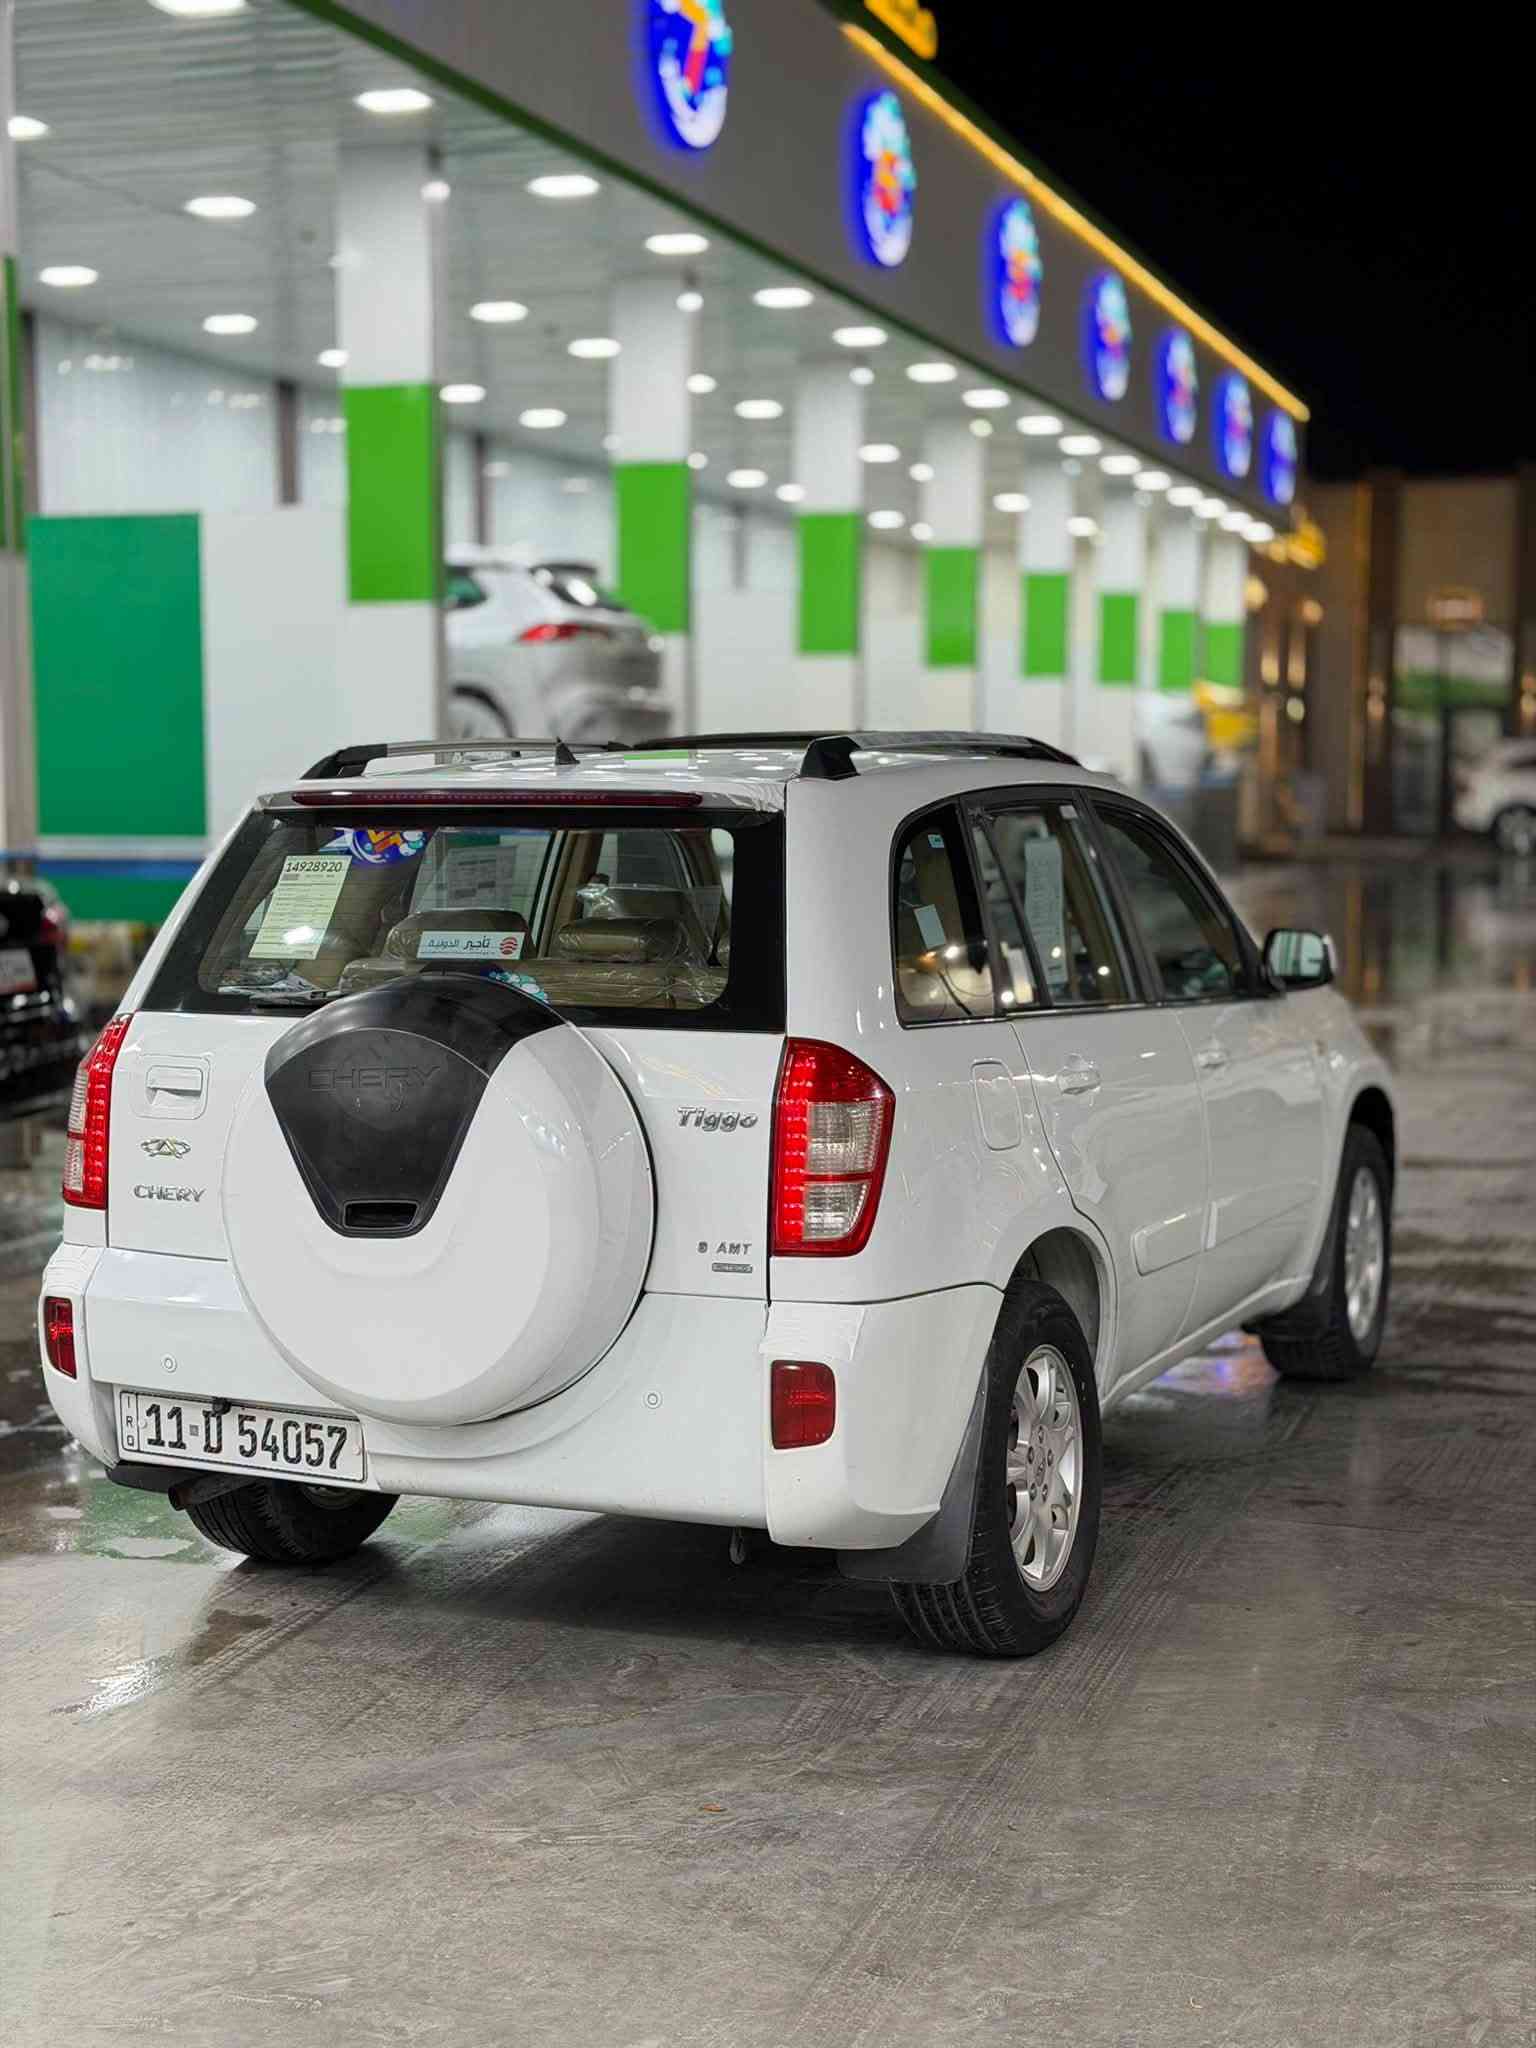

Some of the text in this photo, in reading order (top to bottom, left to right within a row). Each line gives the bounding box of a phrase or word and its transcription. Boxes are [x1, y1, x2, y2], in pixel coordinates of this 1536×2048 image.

[286, 861, 343, 873] 14928920
[463, 935, 492, 951] تأجير
[677, 1105, 759, 1133] Tiggo
[134, 1184, 207, 1202] CHERY
[716, 1241, 753, 1256] AMT
[238, 1413, 348, 1470] 54057
